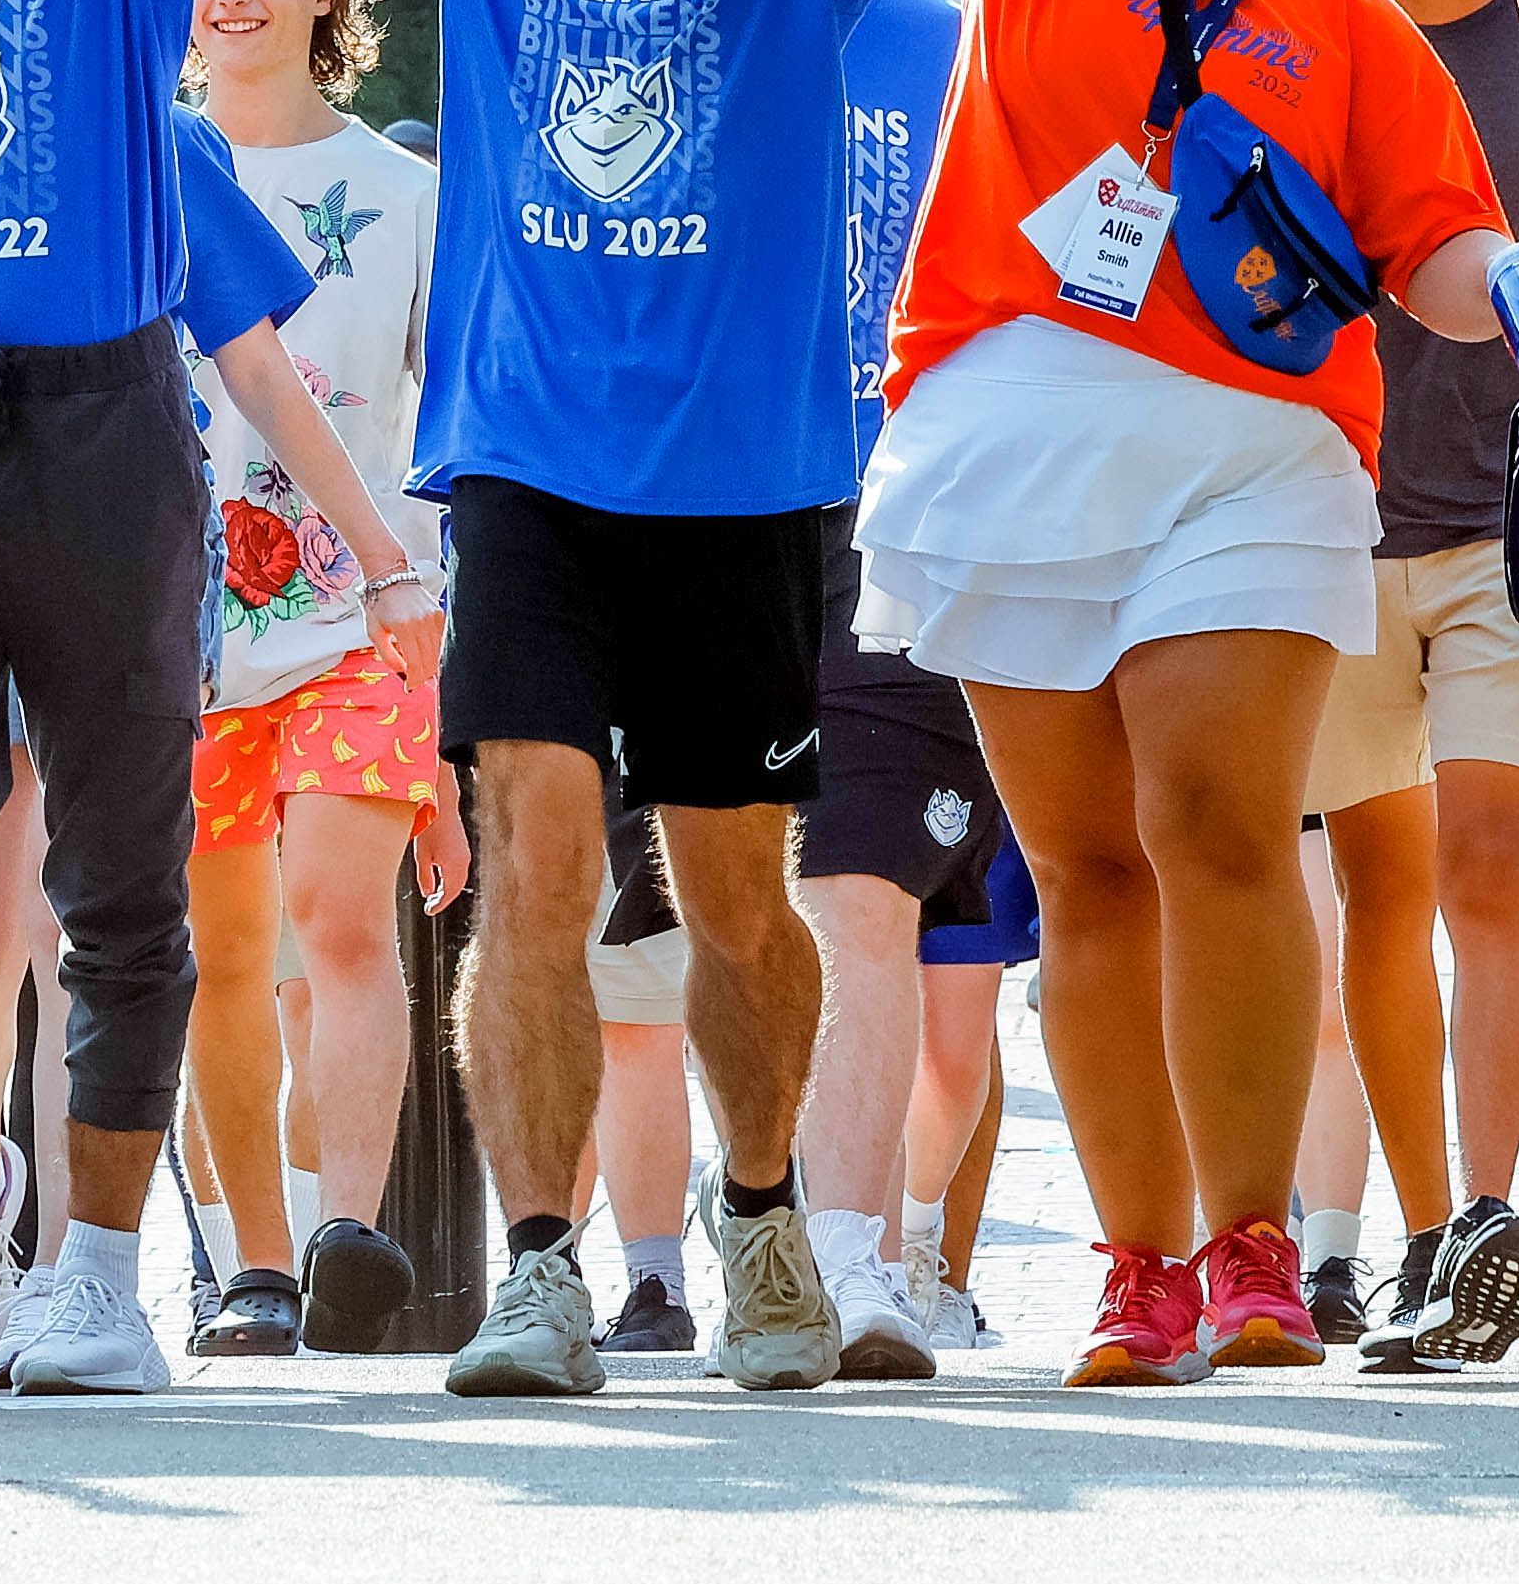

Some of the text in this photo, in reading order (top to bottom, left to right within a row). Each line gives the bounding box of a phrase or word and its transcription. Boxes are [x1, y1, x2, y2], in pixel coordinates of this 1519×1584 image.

[1249, 69, 1302, 109] 2022
[521, 202, 707, 257] SLU 2022
[1099, 218, 1143, 247] Allie
[1097, 249, 1129, 269] Smith
